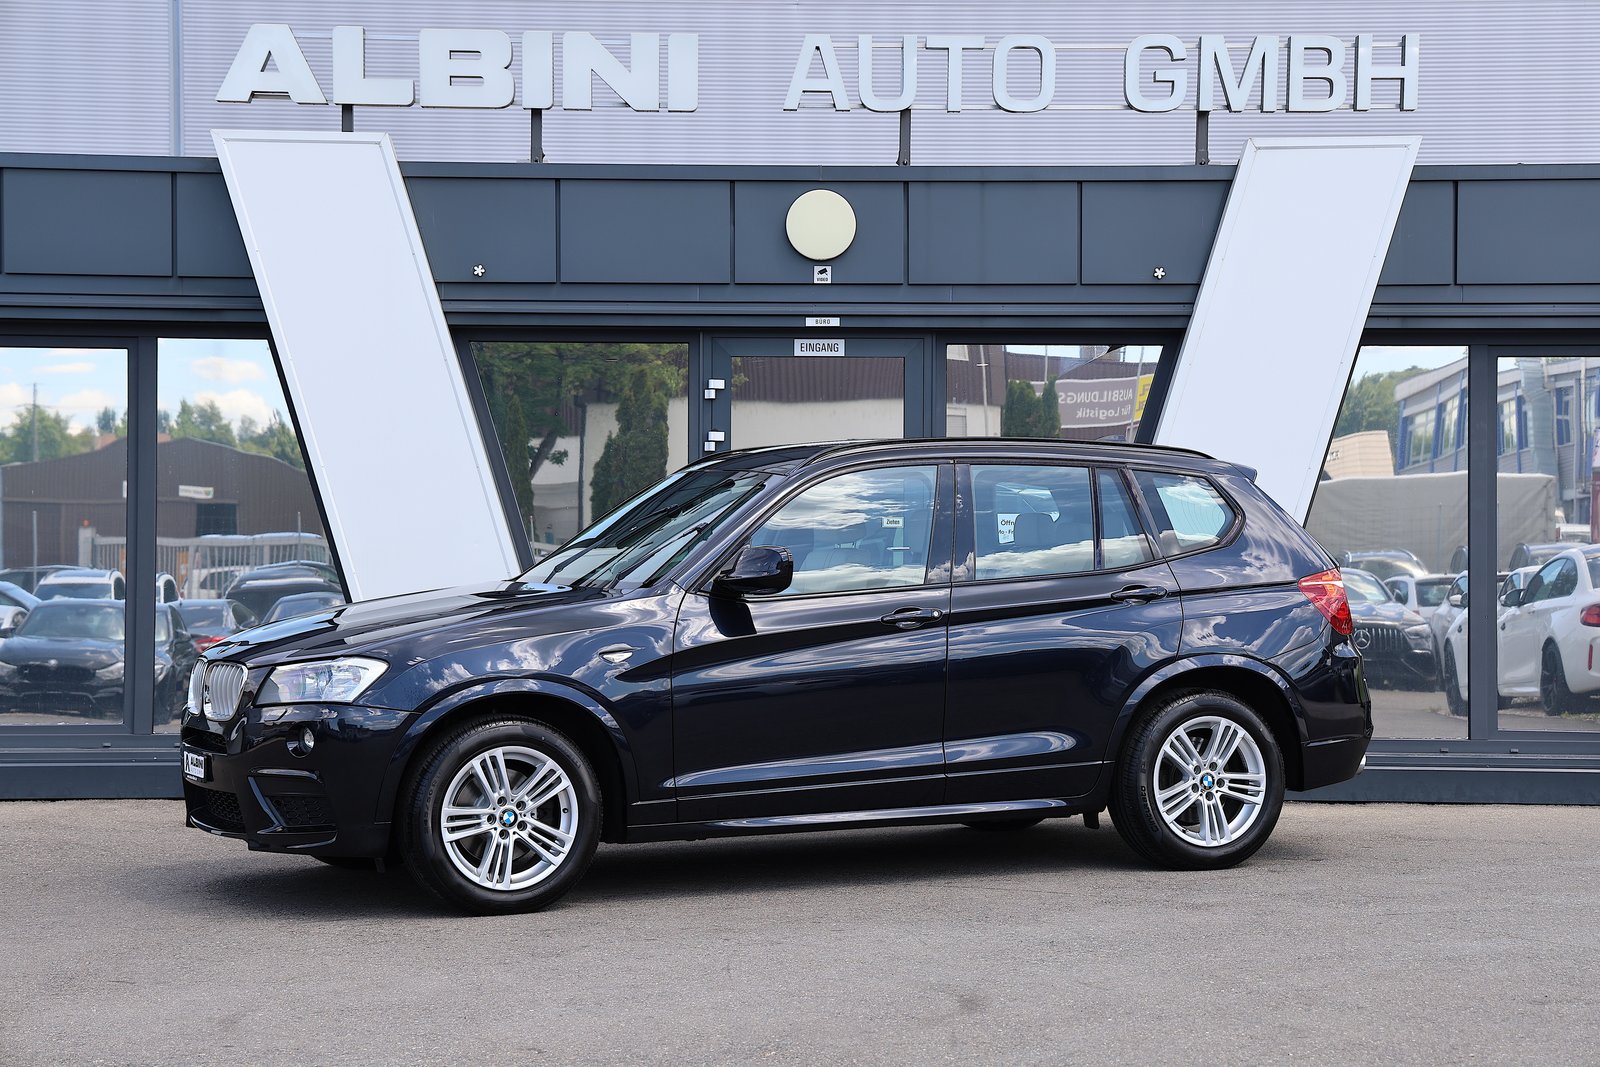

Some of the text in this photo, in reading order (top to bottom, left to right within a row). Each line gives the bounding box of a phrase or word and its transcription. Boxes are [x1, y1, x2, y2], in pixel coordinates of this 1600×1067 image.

[216, 23, 1420, 113] ALBINI AUTO GMBH
[800, 342, 839, 353] EINGANG
